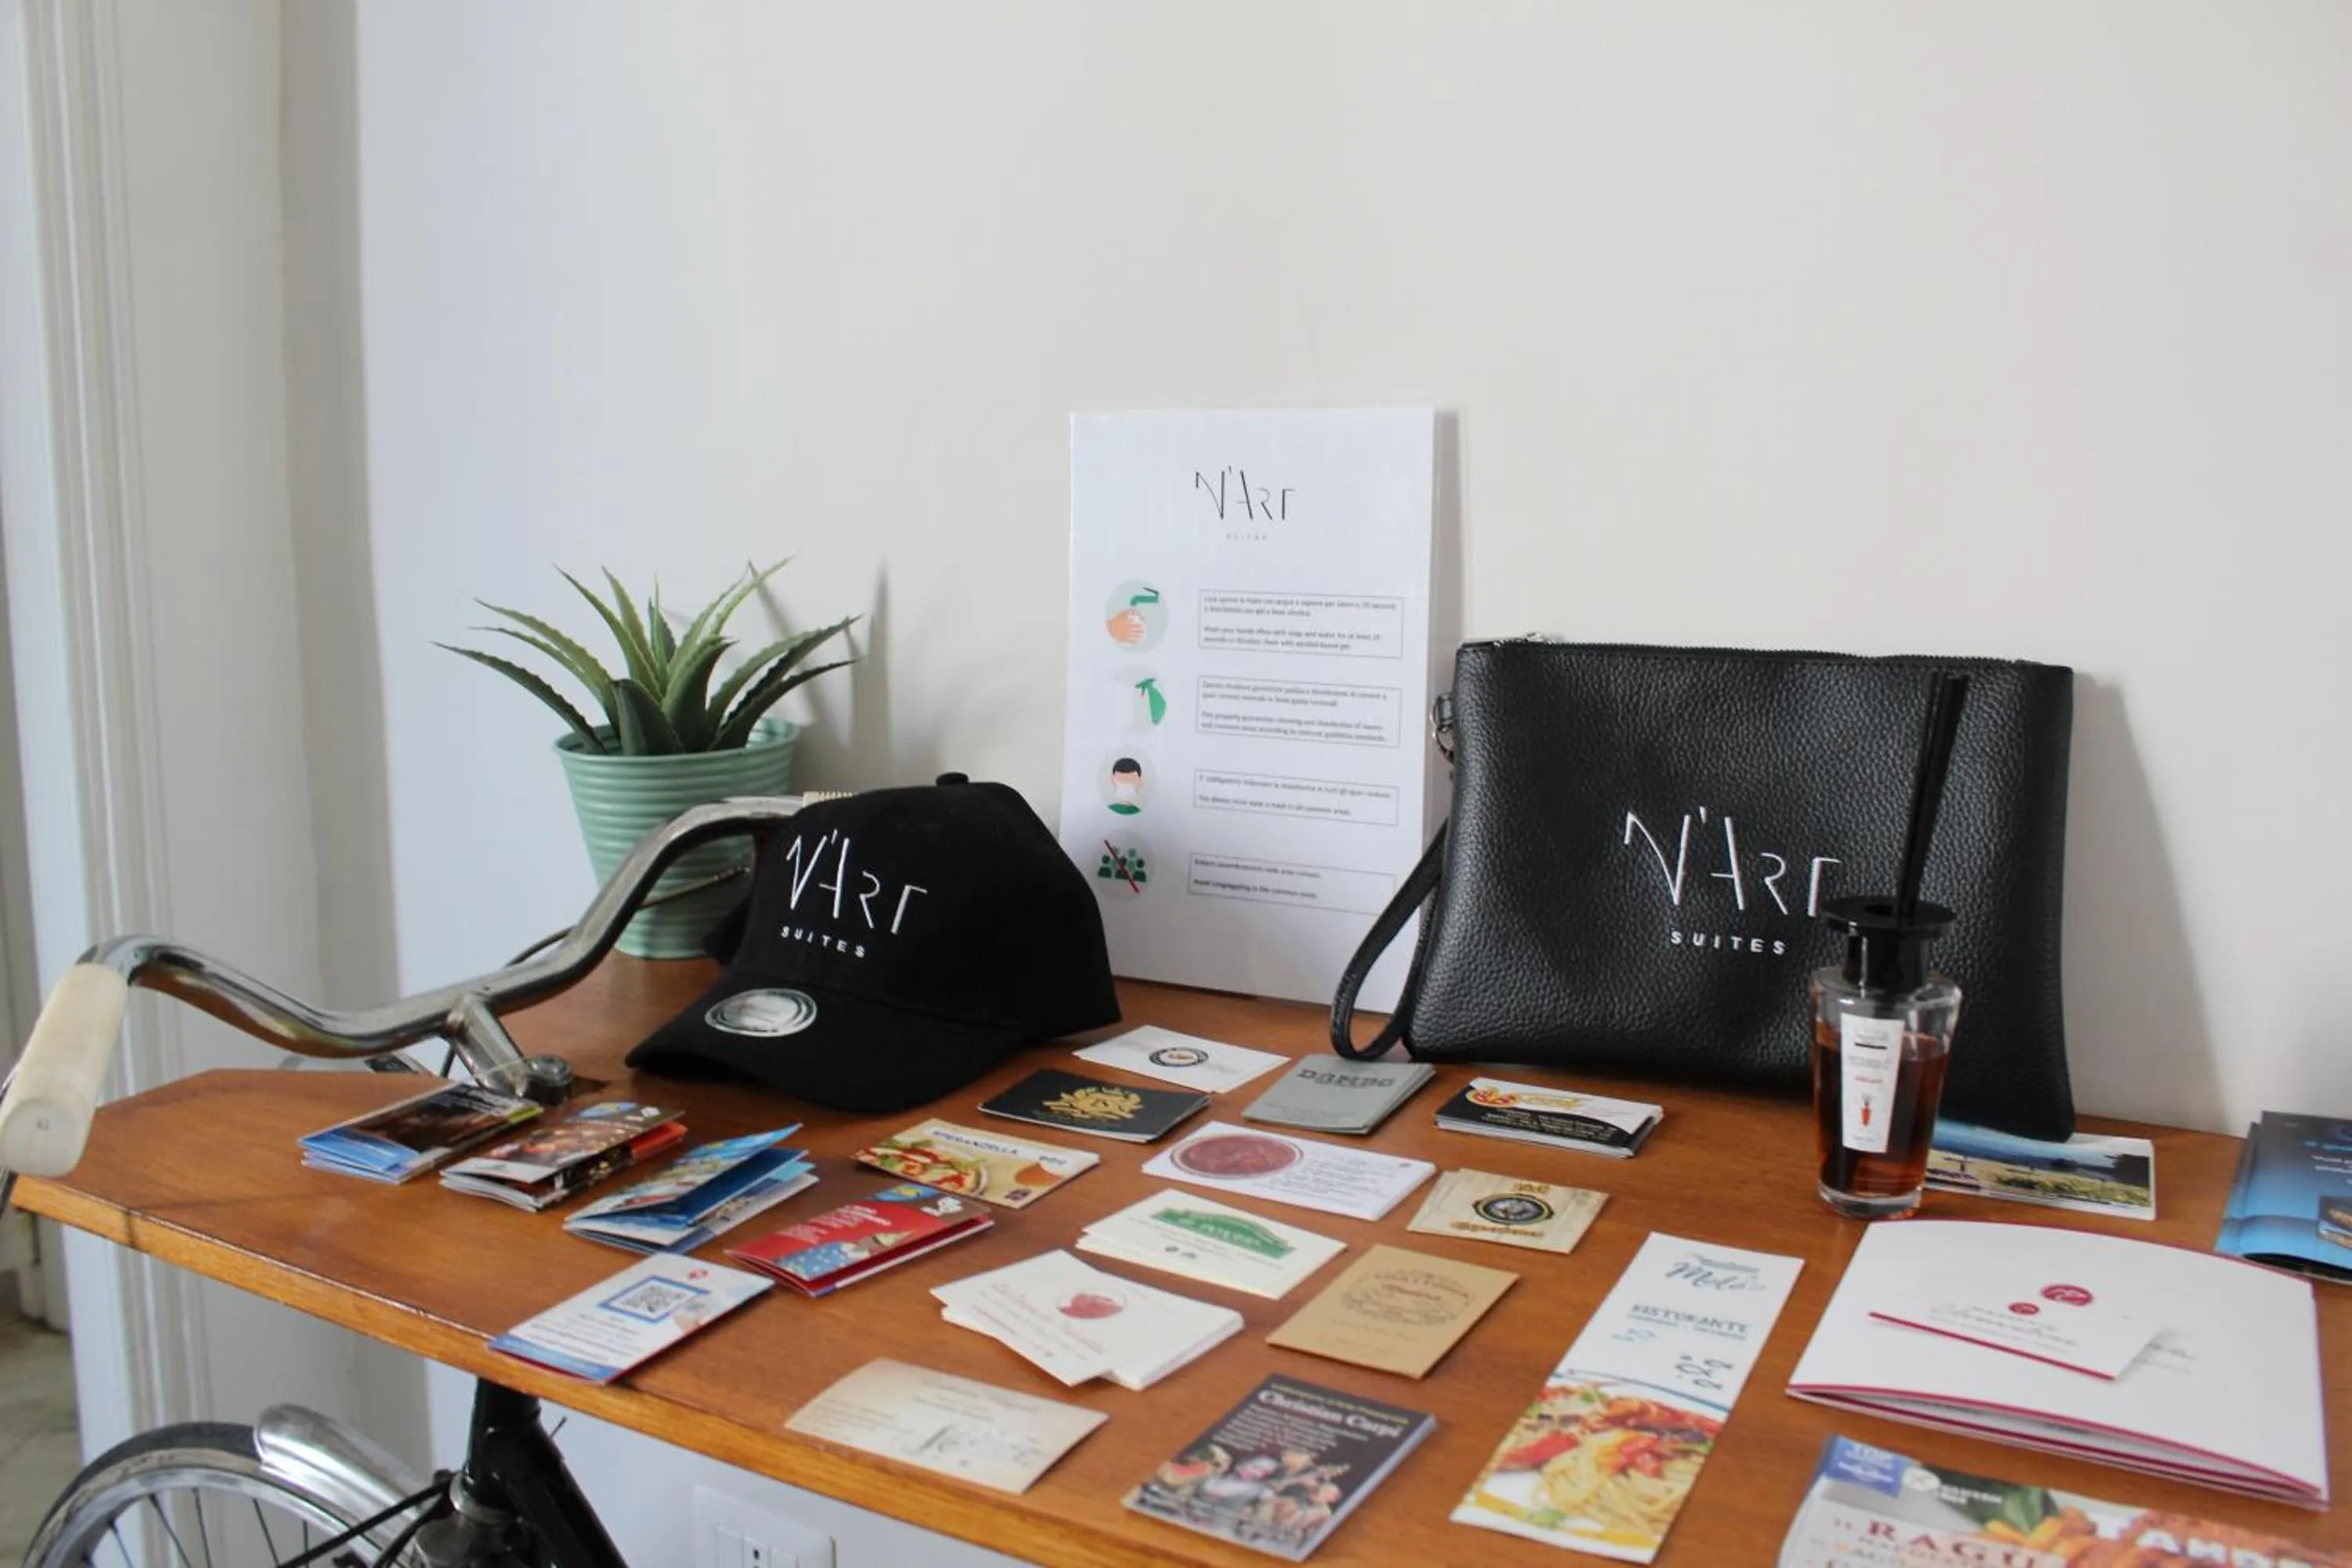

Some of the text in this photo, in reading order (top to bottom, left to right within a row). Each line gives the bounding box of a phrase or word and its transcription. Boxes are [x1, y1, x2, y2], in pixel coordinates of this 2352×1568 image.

[786, 829, 928, 935] N'ART
[1624, 805, 1842, 918] N'ART
[780, 925, 866, 958] SUITES
[1670, 930, 1786, 955] SUITES
